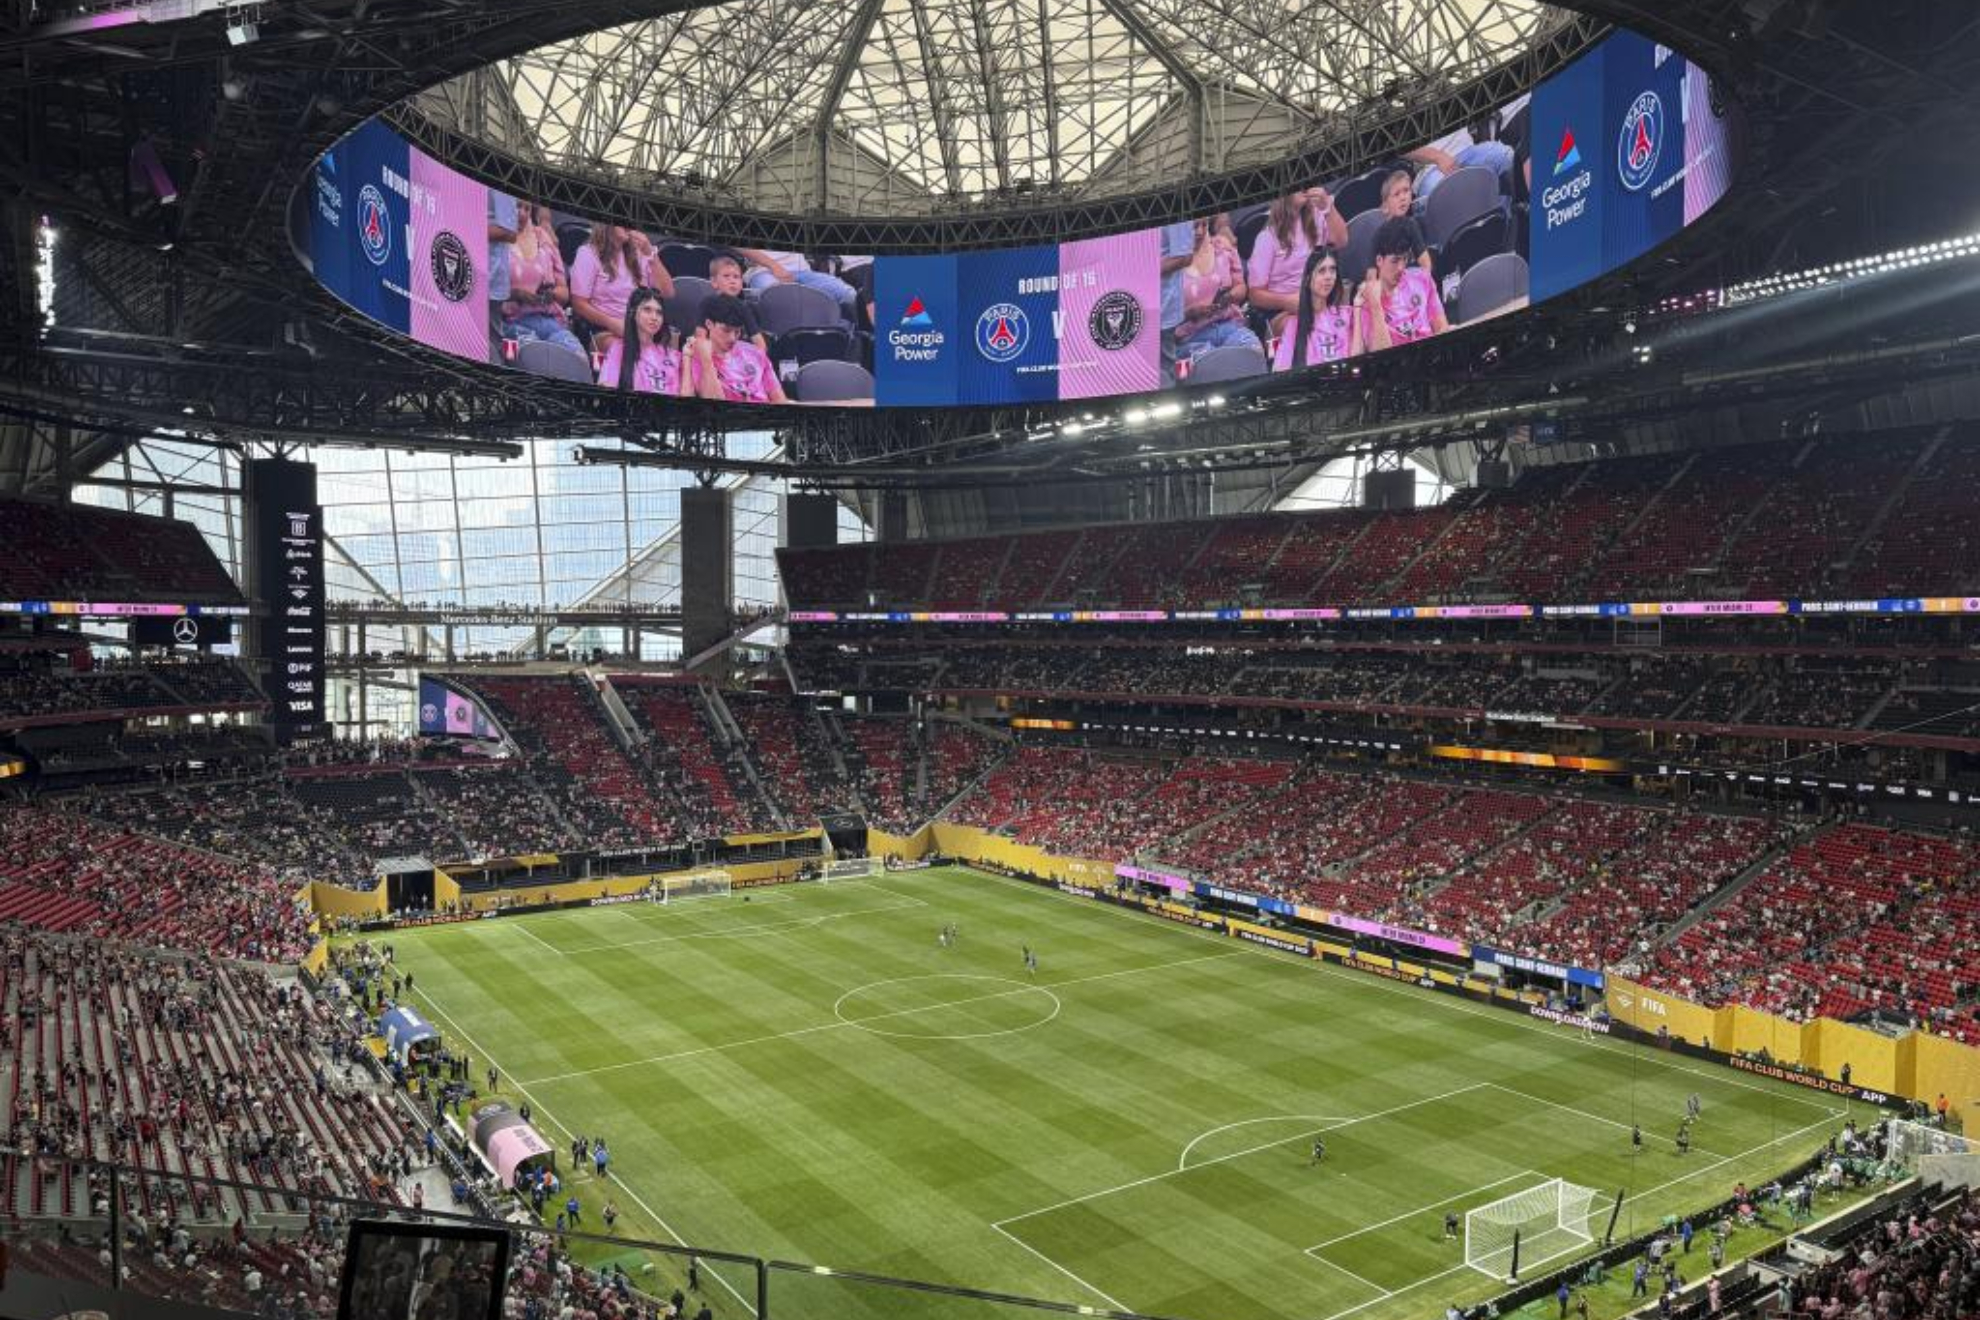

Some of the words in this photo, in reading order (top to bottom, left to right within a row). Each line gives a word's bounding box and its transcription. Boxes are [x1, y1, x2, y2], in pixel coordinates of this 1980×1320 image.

[1624, 97, 1656, 128] PARIS
[1542, 170, 1591, 208] Georgia
[1548, 197, 1586, 231] Power
[1018, 276, 1058, 295] ROUND
[1063, 273, 1077, 289] OF
[1083, 272, 1096, 288] 16
[984, 306, 1020, 320] PARIS
[1051, 310, 1065, 339] V
[889, 330, 944, 347] Georgia
[895, 347, 938, 361] Power
[1642, 997, 1666, 1016] FIFA
[1730, 1057, 1753, 1070] FIFA
[1754, 1063, 1783, 1078] CLUB
[1785, 1071, 1828, 1090] WORLD
[1861, 1091, 1887, 1104] APP
